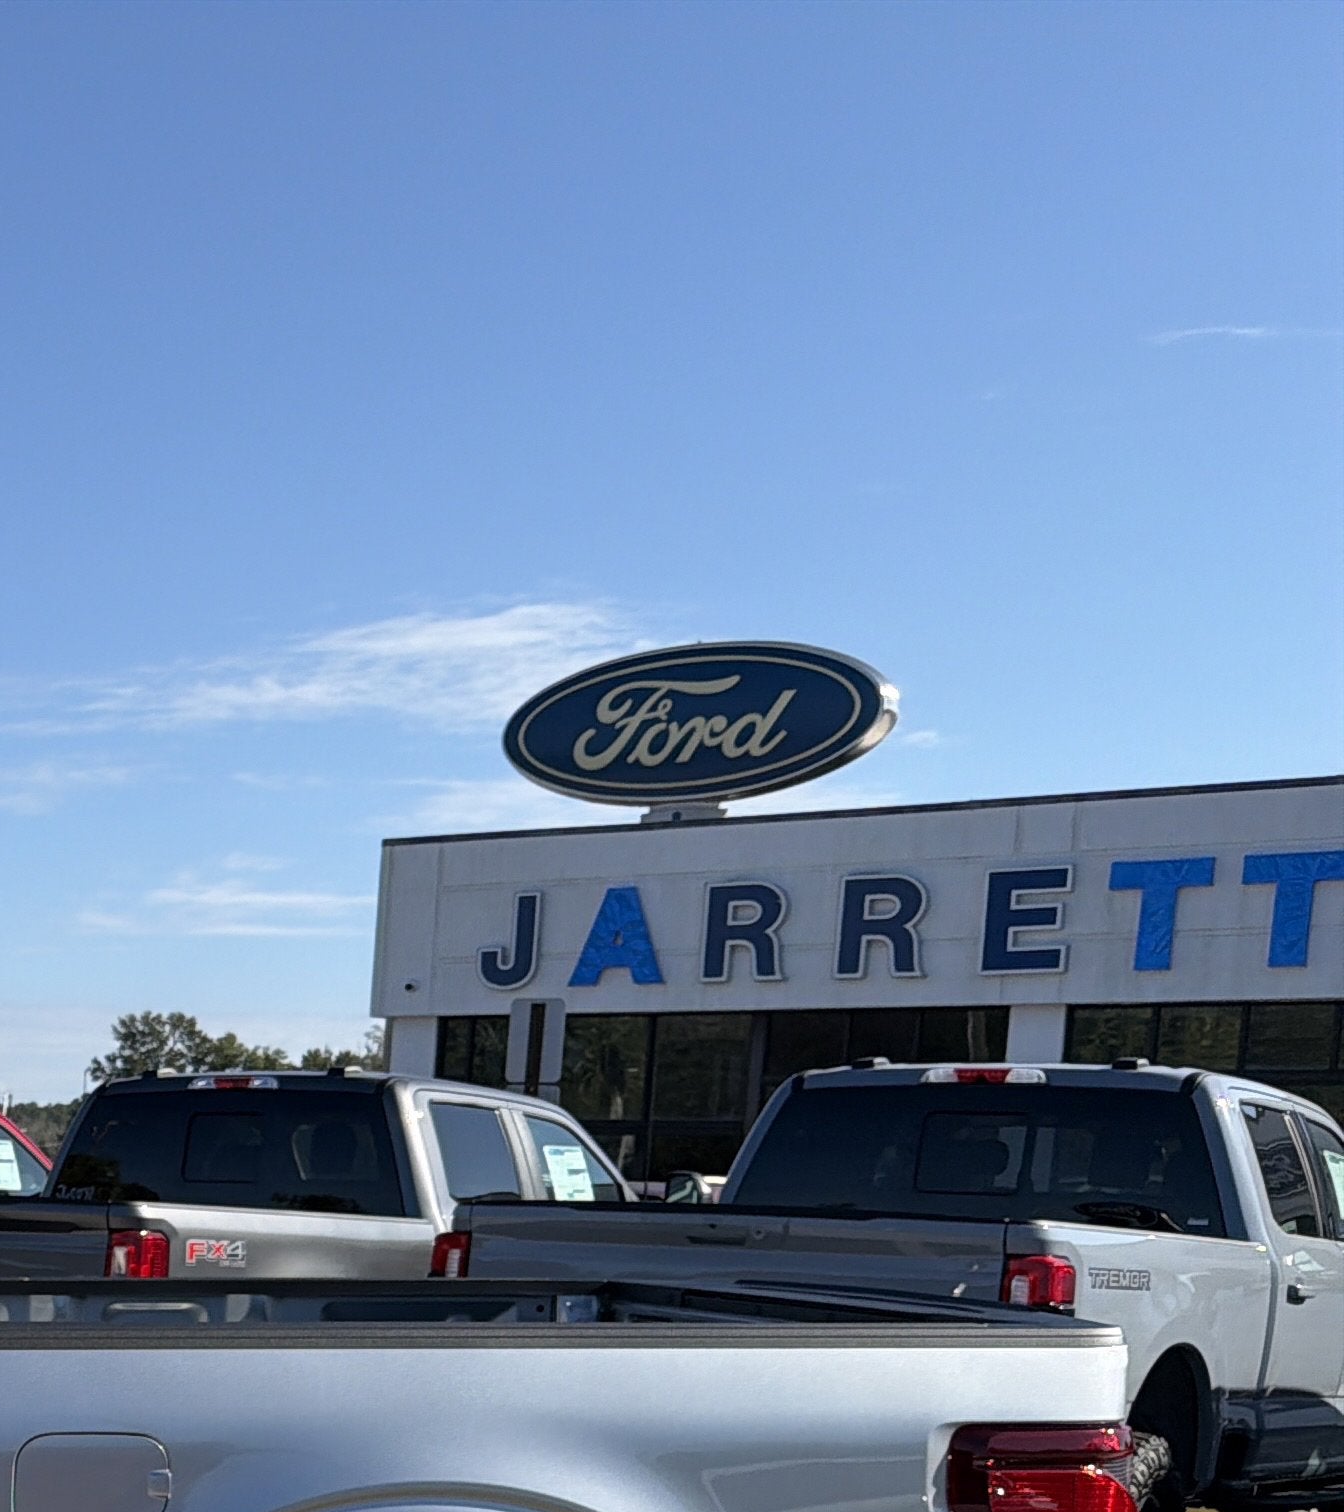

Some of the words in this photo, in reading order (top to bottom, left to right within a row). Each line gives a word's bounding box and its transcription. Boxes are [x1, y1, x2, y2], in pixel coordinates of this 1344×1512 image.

[573, 675, 796, 771] Ford
[477, 850, 1344, 990] JARRETT
[185, 1239, 246, 1266] FX4
[1088, 1267, 1151, 1291] TREMOR
